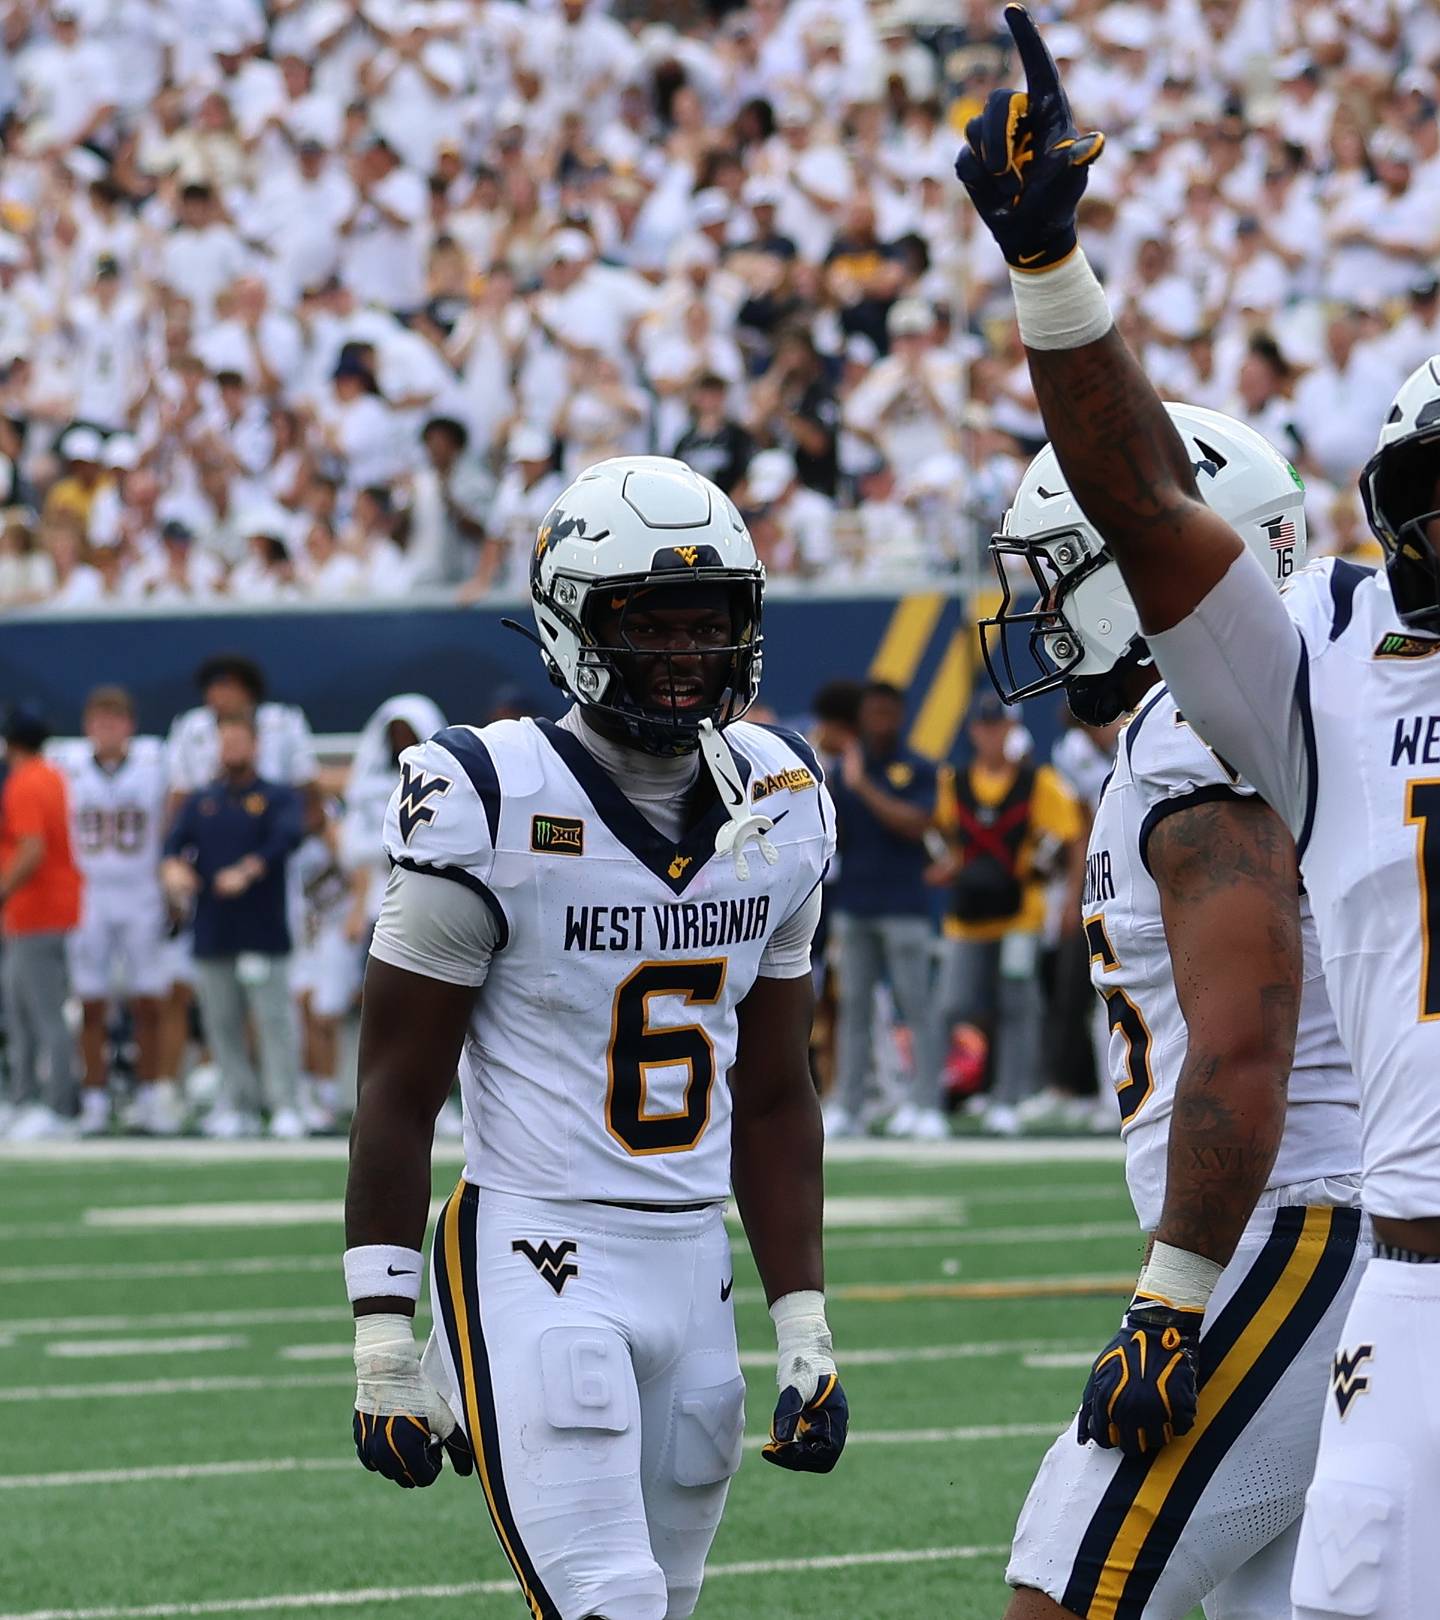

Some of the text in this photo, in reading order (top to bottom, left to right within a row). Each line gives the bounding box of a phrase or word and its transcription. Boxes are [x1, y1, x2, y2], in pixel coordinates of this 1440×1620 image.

[1276, 546, 1294, 579] 16
[766, 767, 810, 794] Antero
[564, 895, 770, 951] WEST VIRGINIA
[604, 956, 728, 1157] 6
